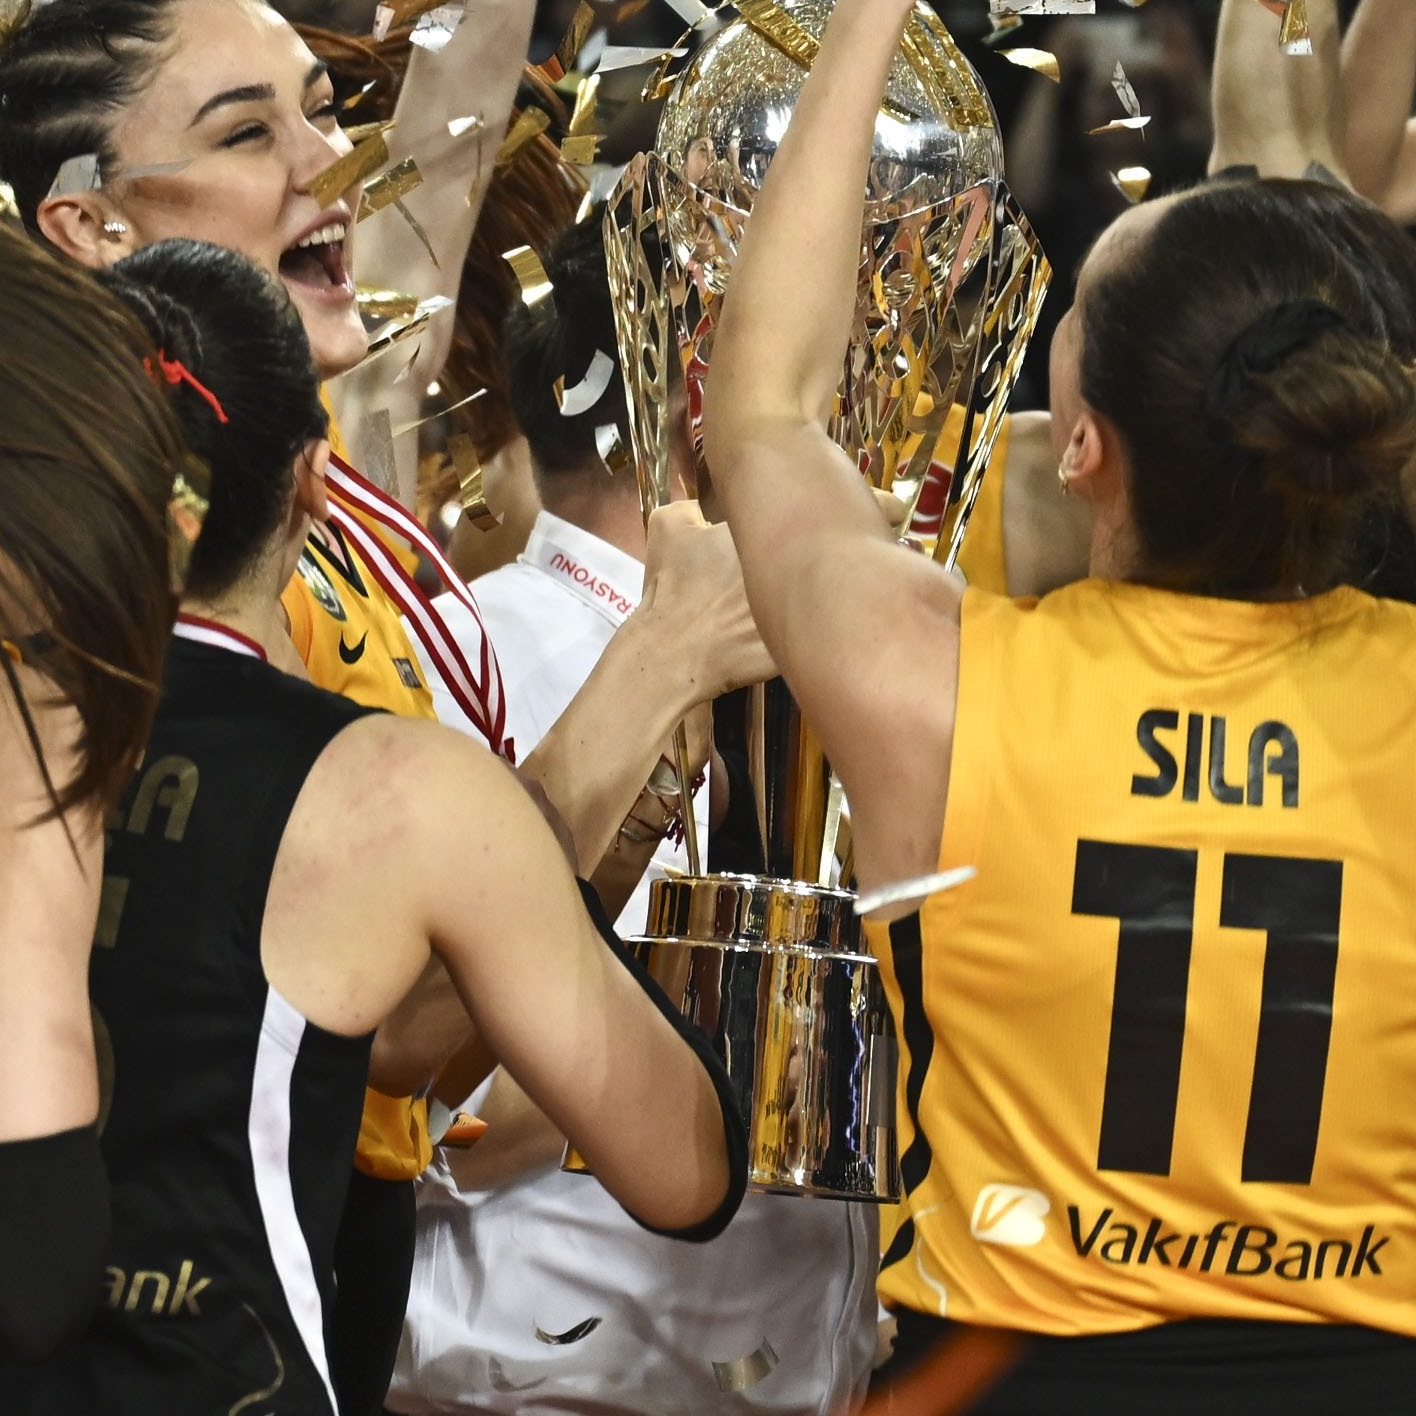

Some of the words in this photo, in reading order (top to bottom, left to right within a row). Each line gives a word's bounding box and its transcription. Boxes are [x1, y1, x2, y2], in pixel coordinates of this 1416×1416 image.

[550, 553, 633, 617] RASYONU
[1131, 709, 1300, 809] SILA
[1071, 837, 1344, 1186] 11
